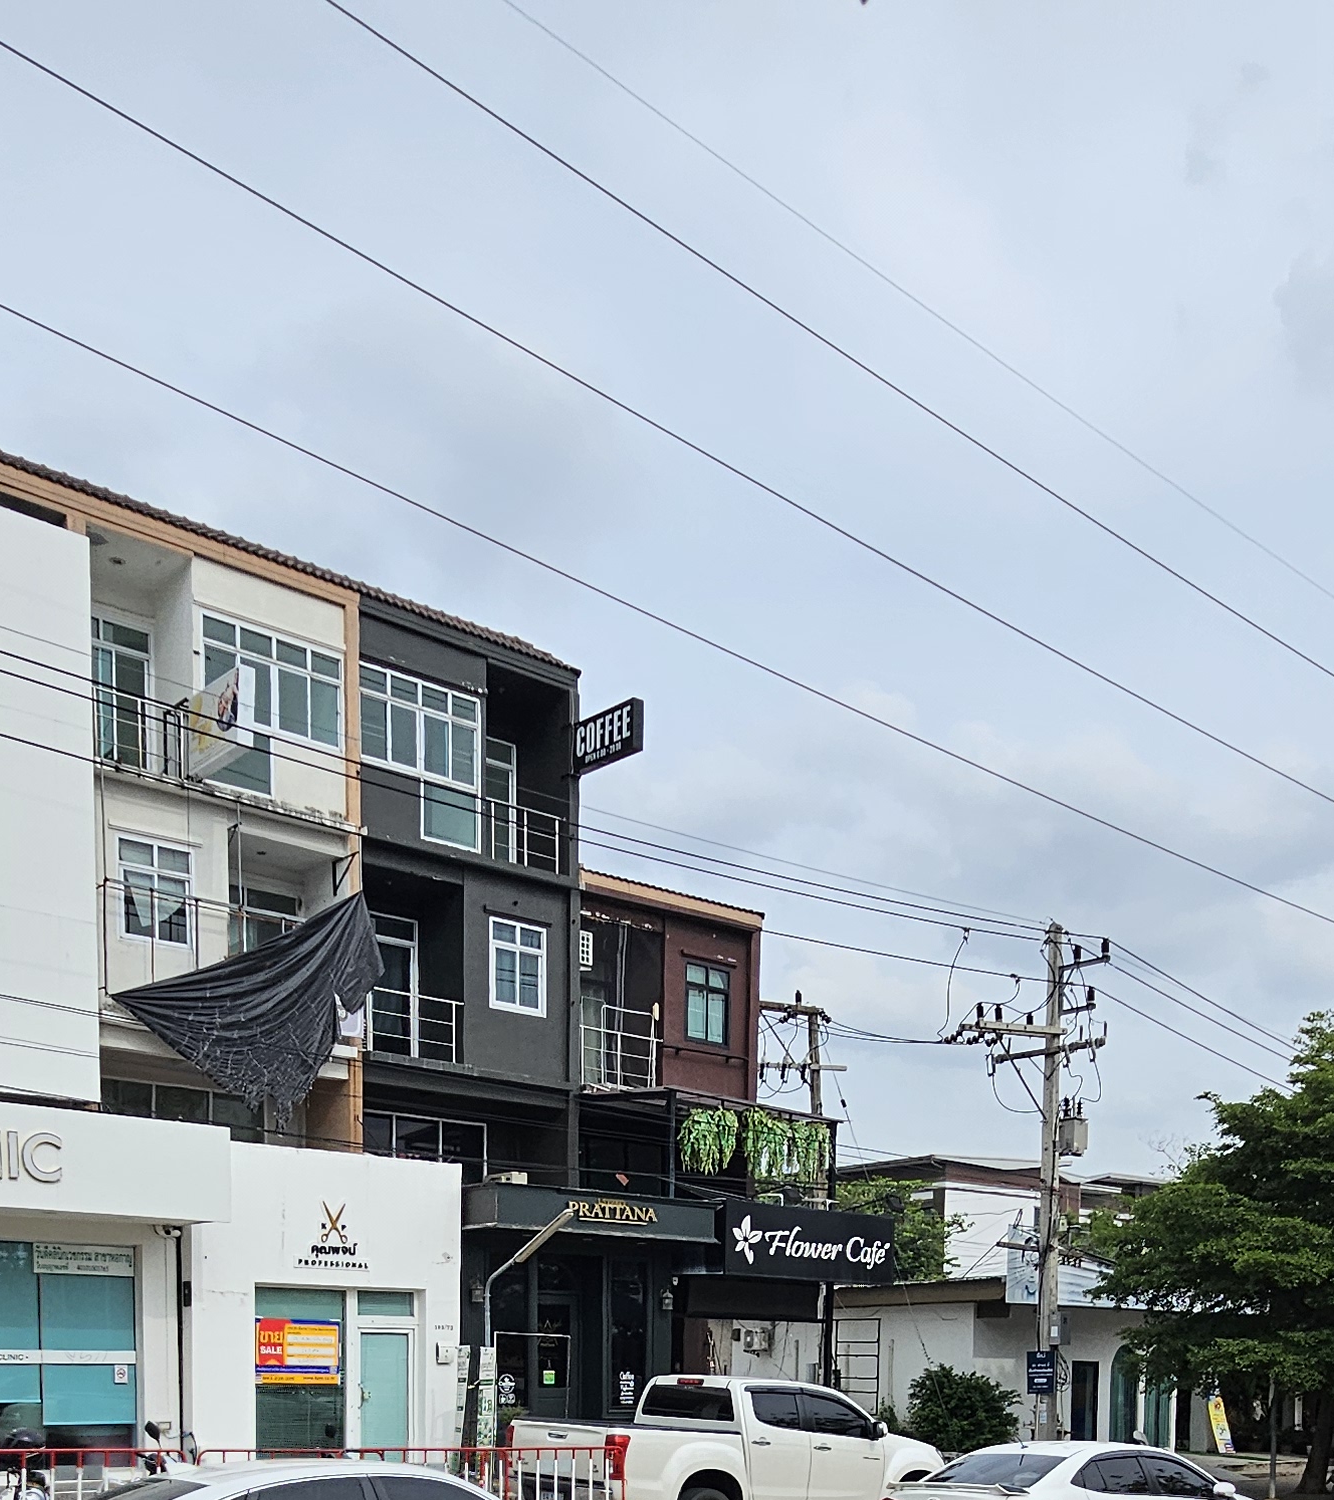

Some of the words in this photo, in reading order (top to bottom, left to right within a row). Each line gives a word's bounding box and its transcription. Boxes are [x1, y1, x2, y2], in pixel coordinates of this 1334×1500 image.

[576, 705, 631, 757] COFFEE
[568, 1200, 658, 1222] PRATTANA
[764, 1226, 842, 1261] Flower
[846, 1236, 890, 1269] Café
[297, 1258, 368, 1269] PROFESSIONAL
[259, 1331, 283, 1343] ขาย
[259, 1345, 283, 1355] SALE
